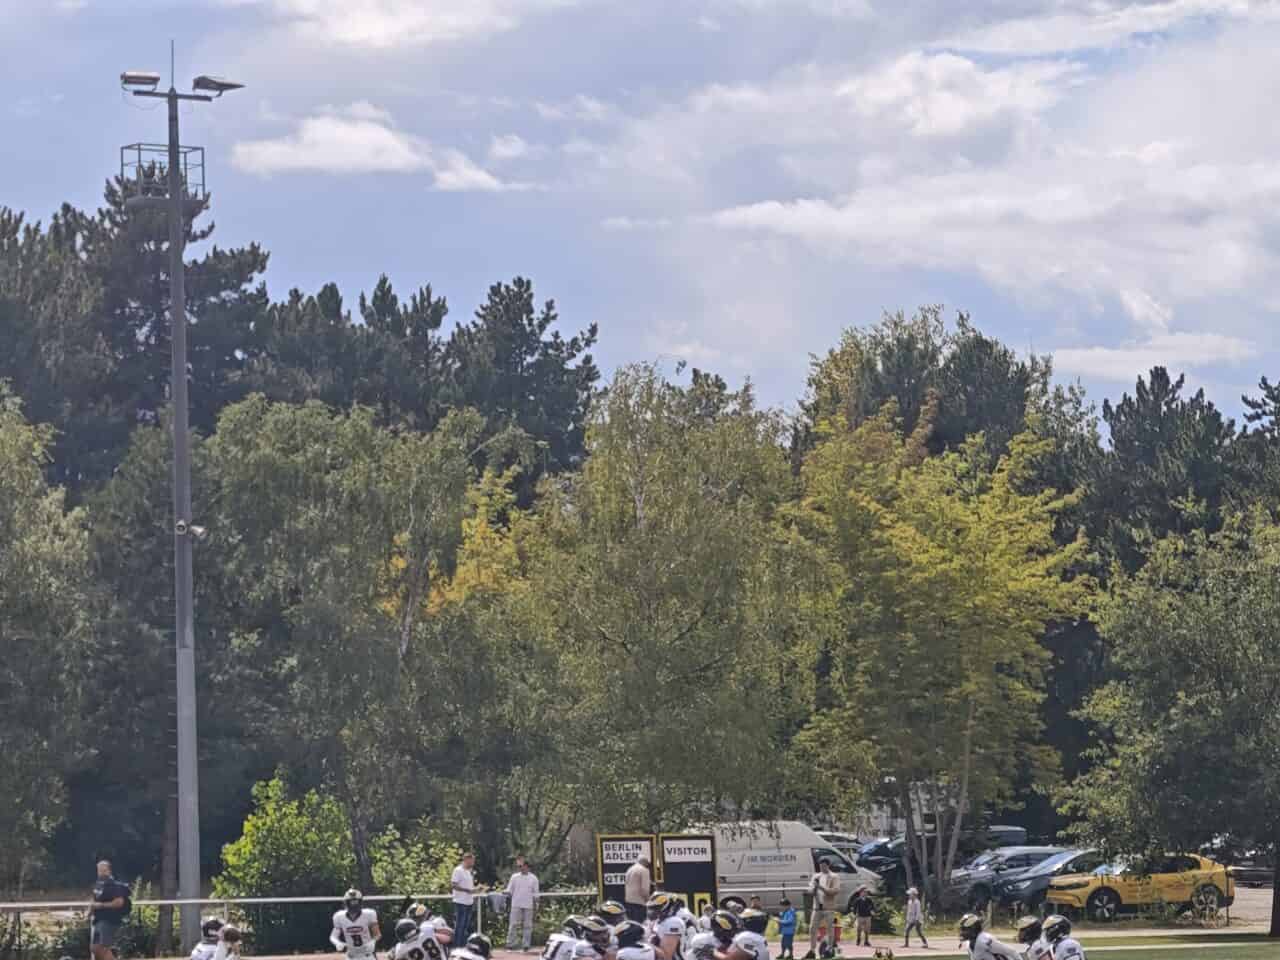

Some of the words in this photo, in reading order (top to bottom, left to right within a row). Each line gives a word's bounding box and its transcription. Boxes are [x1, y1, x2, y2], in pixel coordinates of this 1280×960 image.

[604, 843, 642, 852] BERLIN
[665, 847, 708, 856] VISITOR
[605, 852, 639, 860] ADLER
